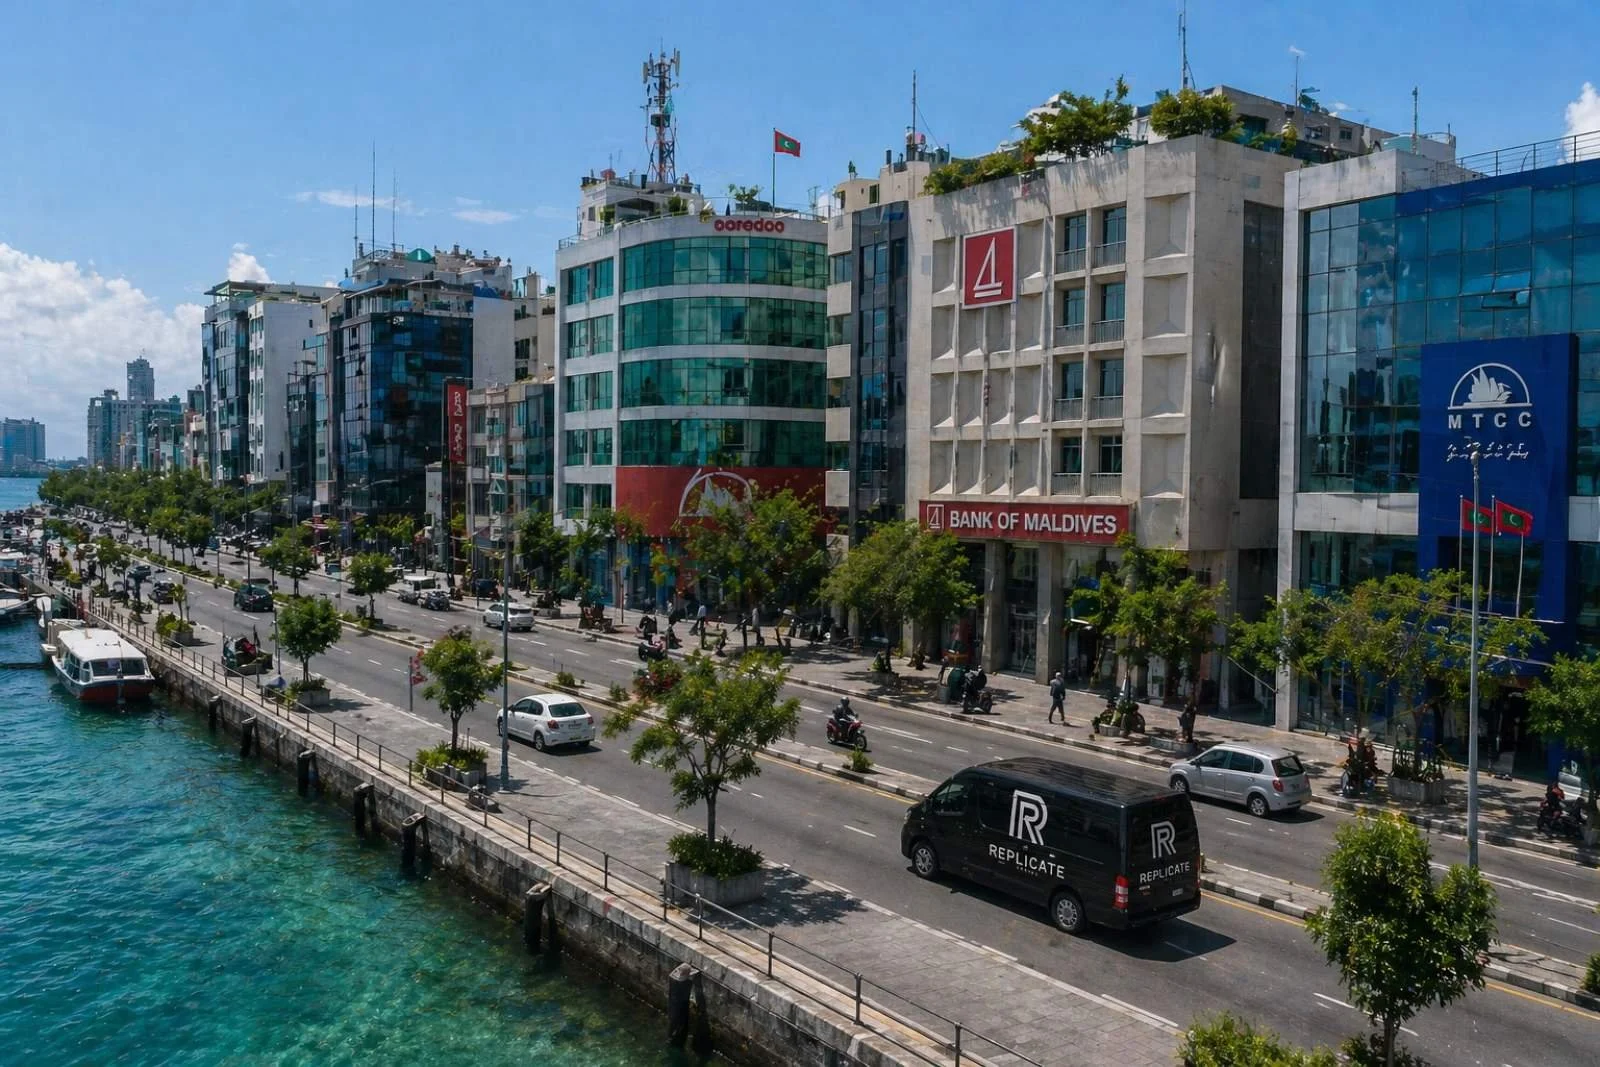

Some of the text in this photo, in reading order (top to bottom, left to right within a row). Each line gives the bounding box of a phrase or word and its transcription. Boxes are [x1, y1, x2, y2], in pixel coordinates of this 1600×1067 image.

[714, 218, 785, 233] ooredoo
[950, 510, 1117, 534] BANK OF MALDIVES
[989, 843, 1065, 879] REPLICATE
[1139, 861, 1190, 884] REPLICATE
